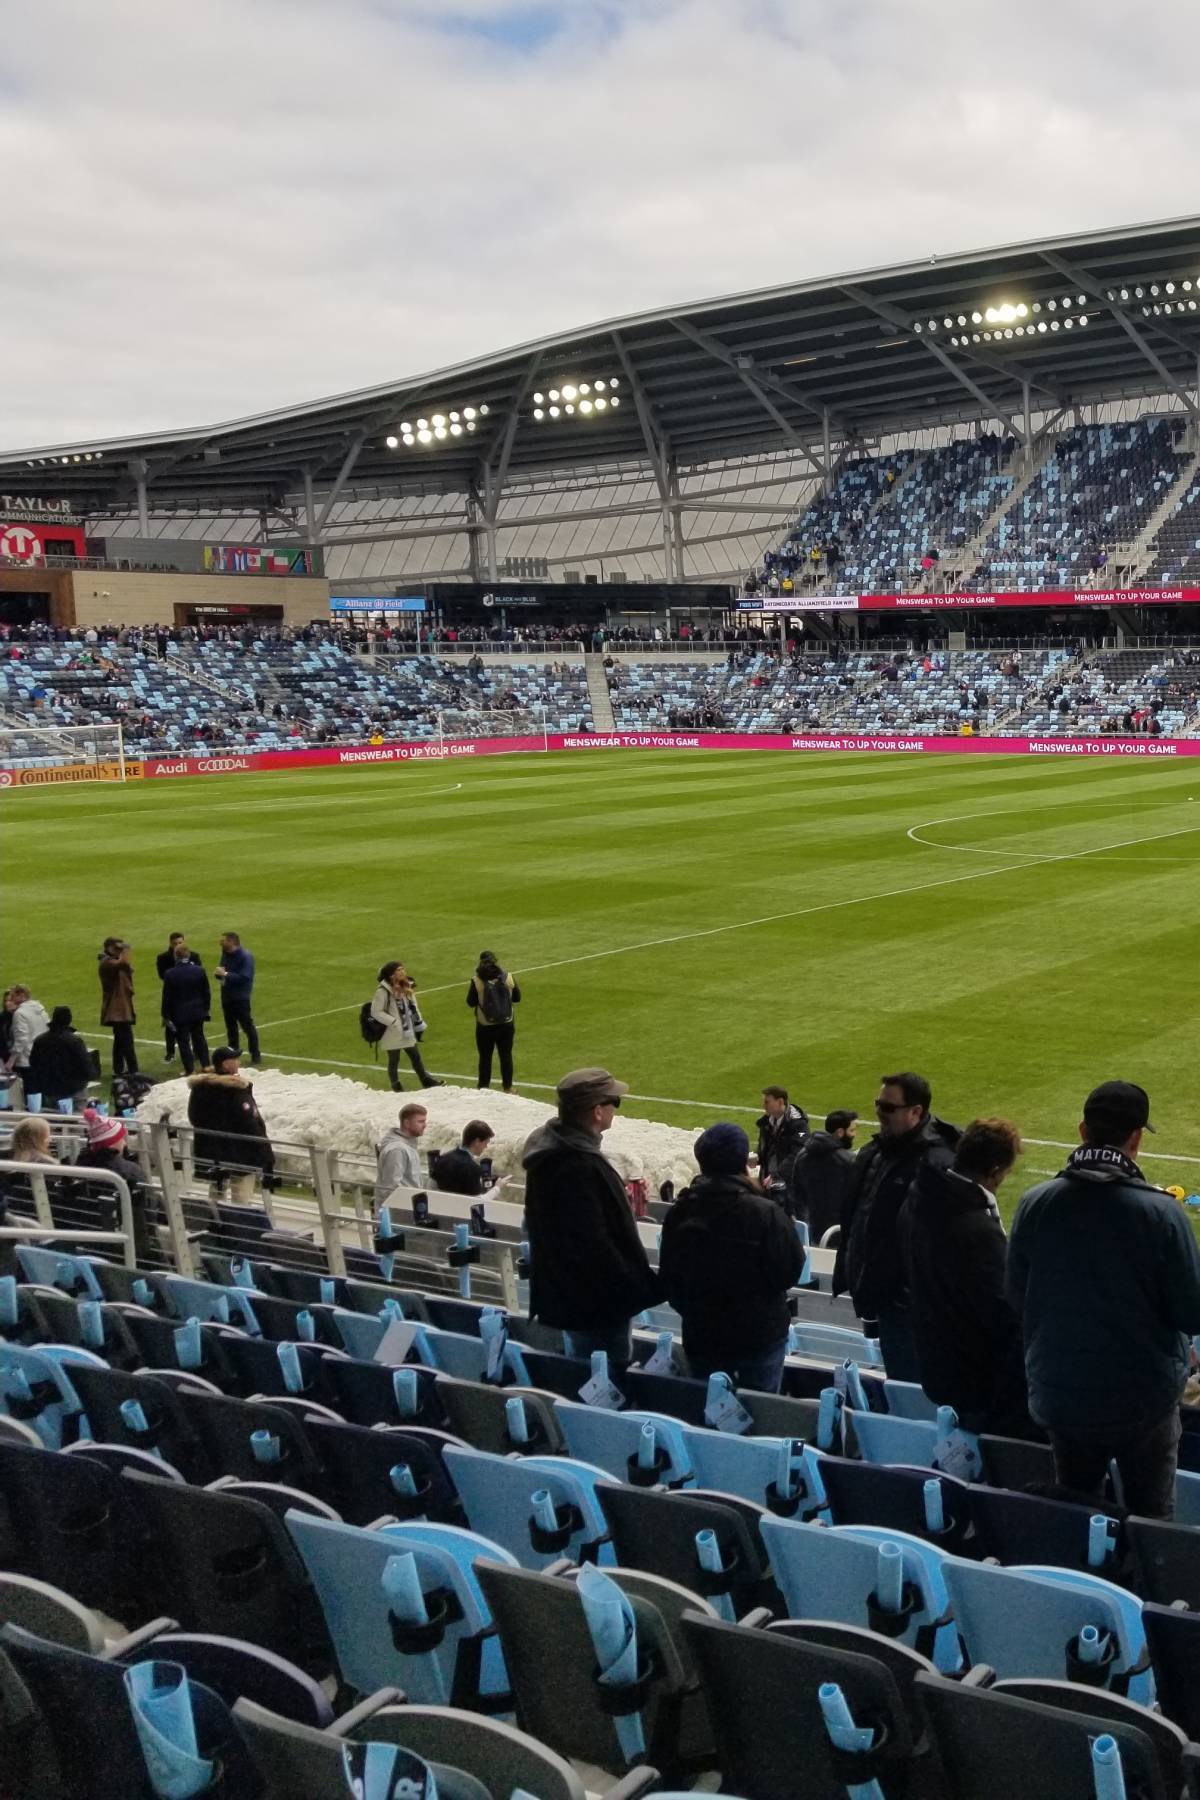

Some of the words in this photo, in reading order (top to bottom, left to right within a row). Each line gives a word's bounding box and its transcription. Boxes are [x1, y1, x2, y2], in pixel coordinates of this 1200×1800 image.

[2, 496, 71, 512] TAYLOR
[0, 511, 82, 523] OMMUNICATIONS
[564, 738, 620, 747] MENSWEAR
[623, 736, 637, 745] TO
[640, 737, 650, 745] UP
[652, 737, 675, 746] YOUR
[676, 738, 699, 746] GAME
[793, 740, 840, 748] MENSWEAR
[843, 740, 856, 748] TO
[858, 740, 869, 748] UP
[872, 741, 896, 749] YOUR
[898, 741, 923, 750] GAME
[340, 751, 393, 761] MENSWEAR
[395, 749, 407, 758] TO
[410, 748, 422, 757] UP
[424, 746, 448, 756] YOUR
[451, 745, 475, 754] GAME
[1030, 742, 1083, 752] MENSWEAR
[1086, 743, 1100, 752] TO
[1102, 744, 1116, 752] UP
[1118, 744, 1146, 753] YOUR
[1148, 744, 1176, 754] GAME
[156, 762, 187, 774] Audi
[20, 766, 98, 785] Continental
[1074, 1149, 1122, 1164] MATCH
